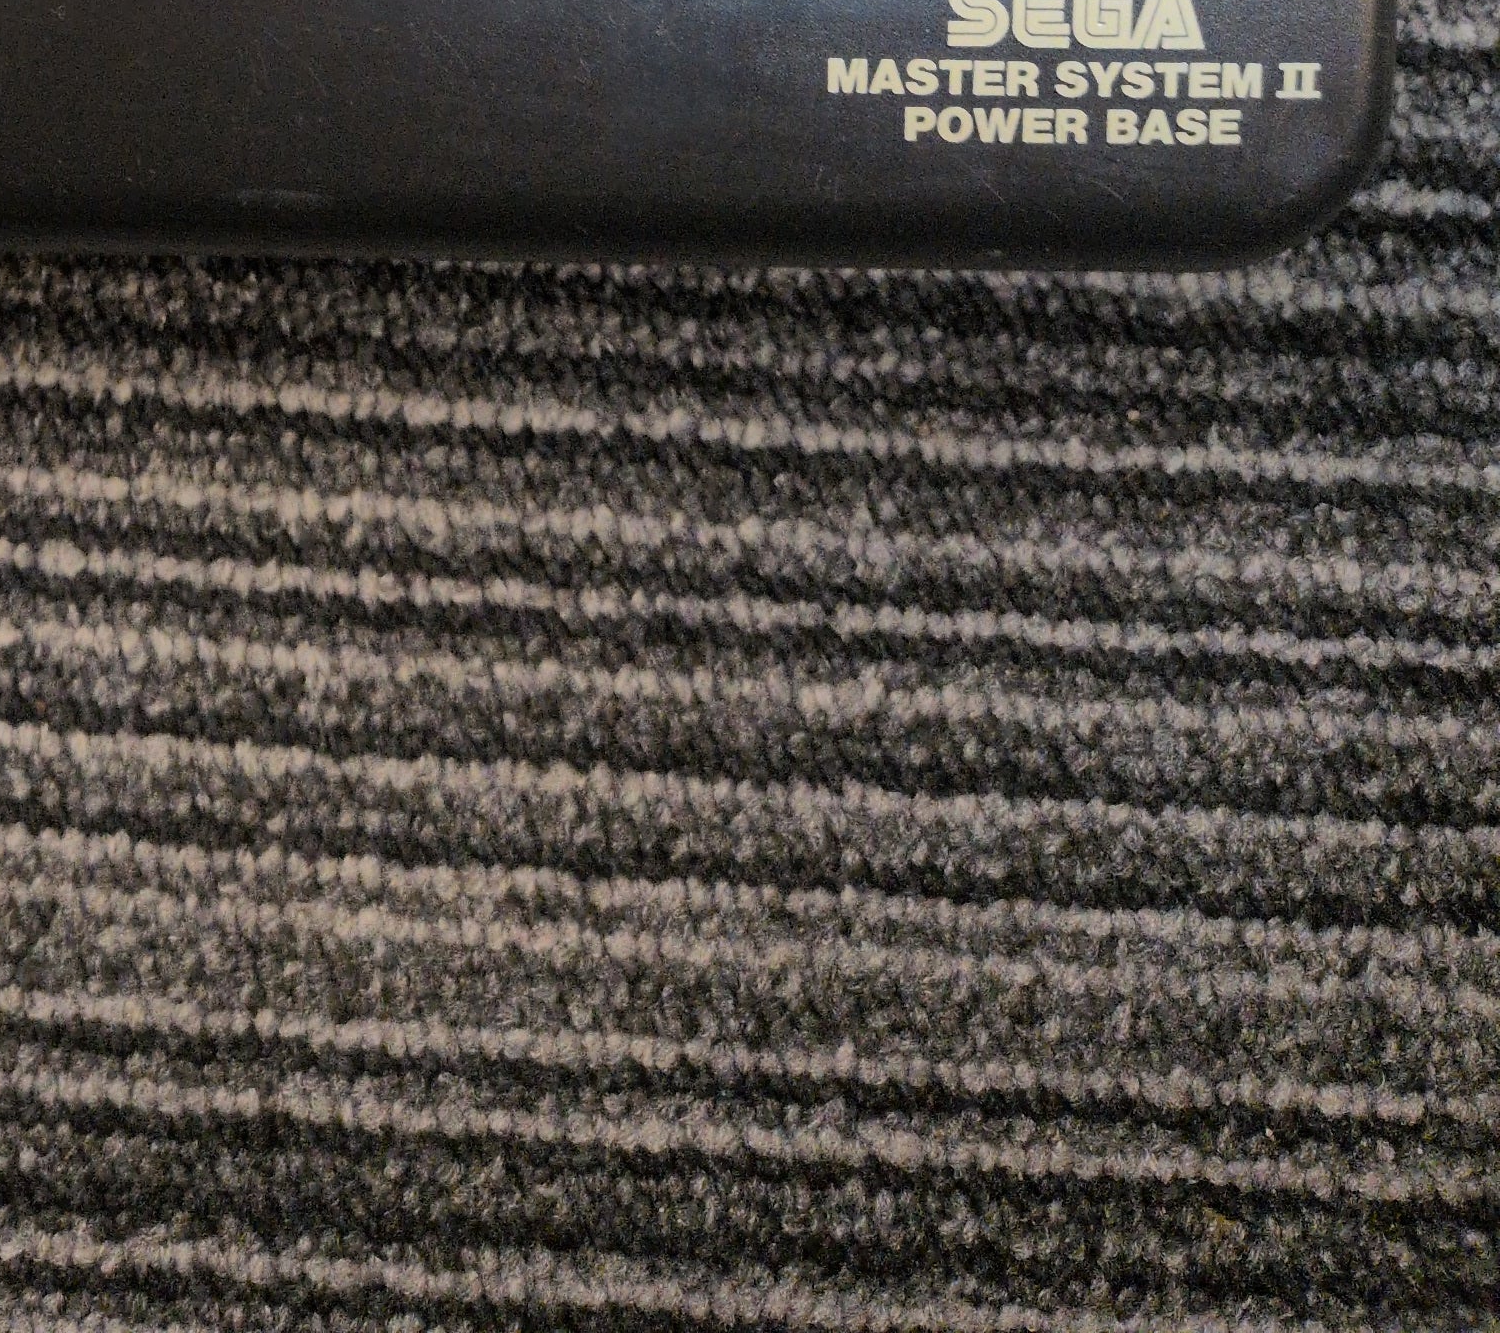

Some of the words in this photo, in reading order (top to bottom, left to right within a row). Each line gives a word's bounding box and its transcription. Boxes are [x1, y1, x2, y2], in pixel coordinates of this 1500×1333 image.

[827, 58, 1039, 97] MASTER
[1055, 60, 1263, 99] SYSTEM
[1276, 63, 1322, 99] II
[903, 106, 1088, 145] POWER
[1106, 109, 1242, 145] BASE
